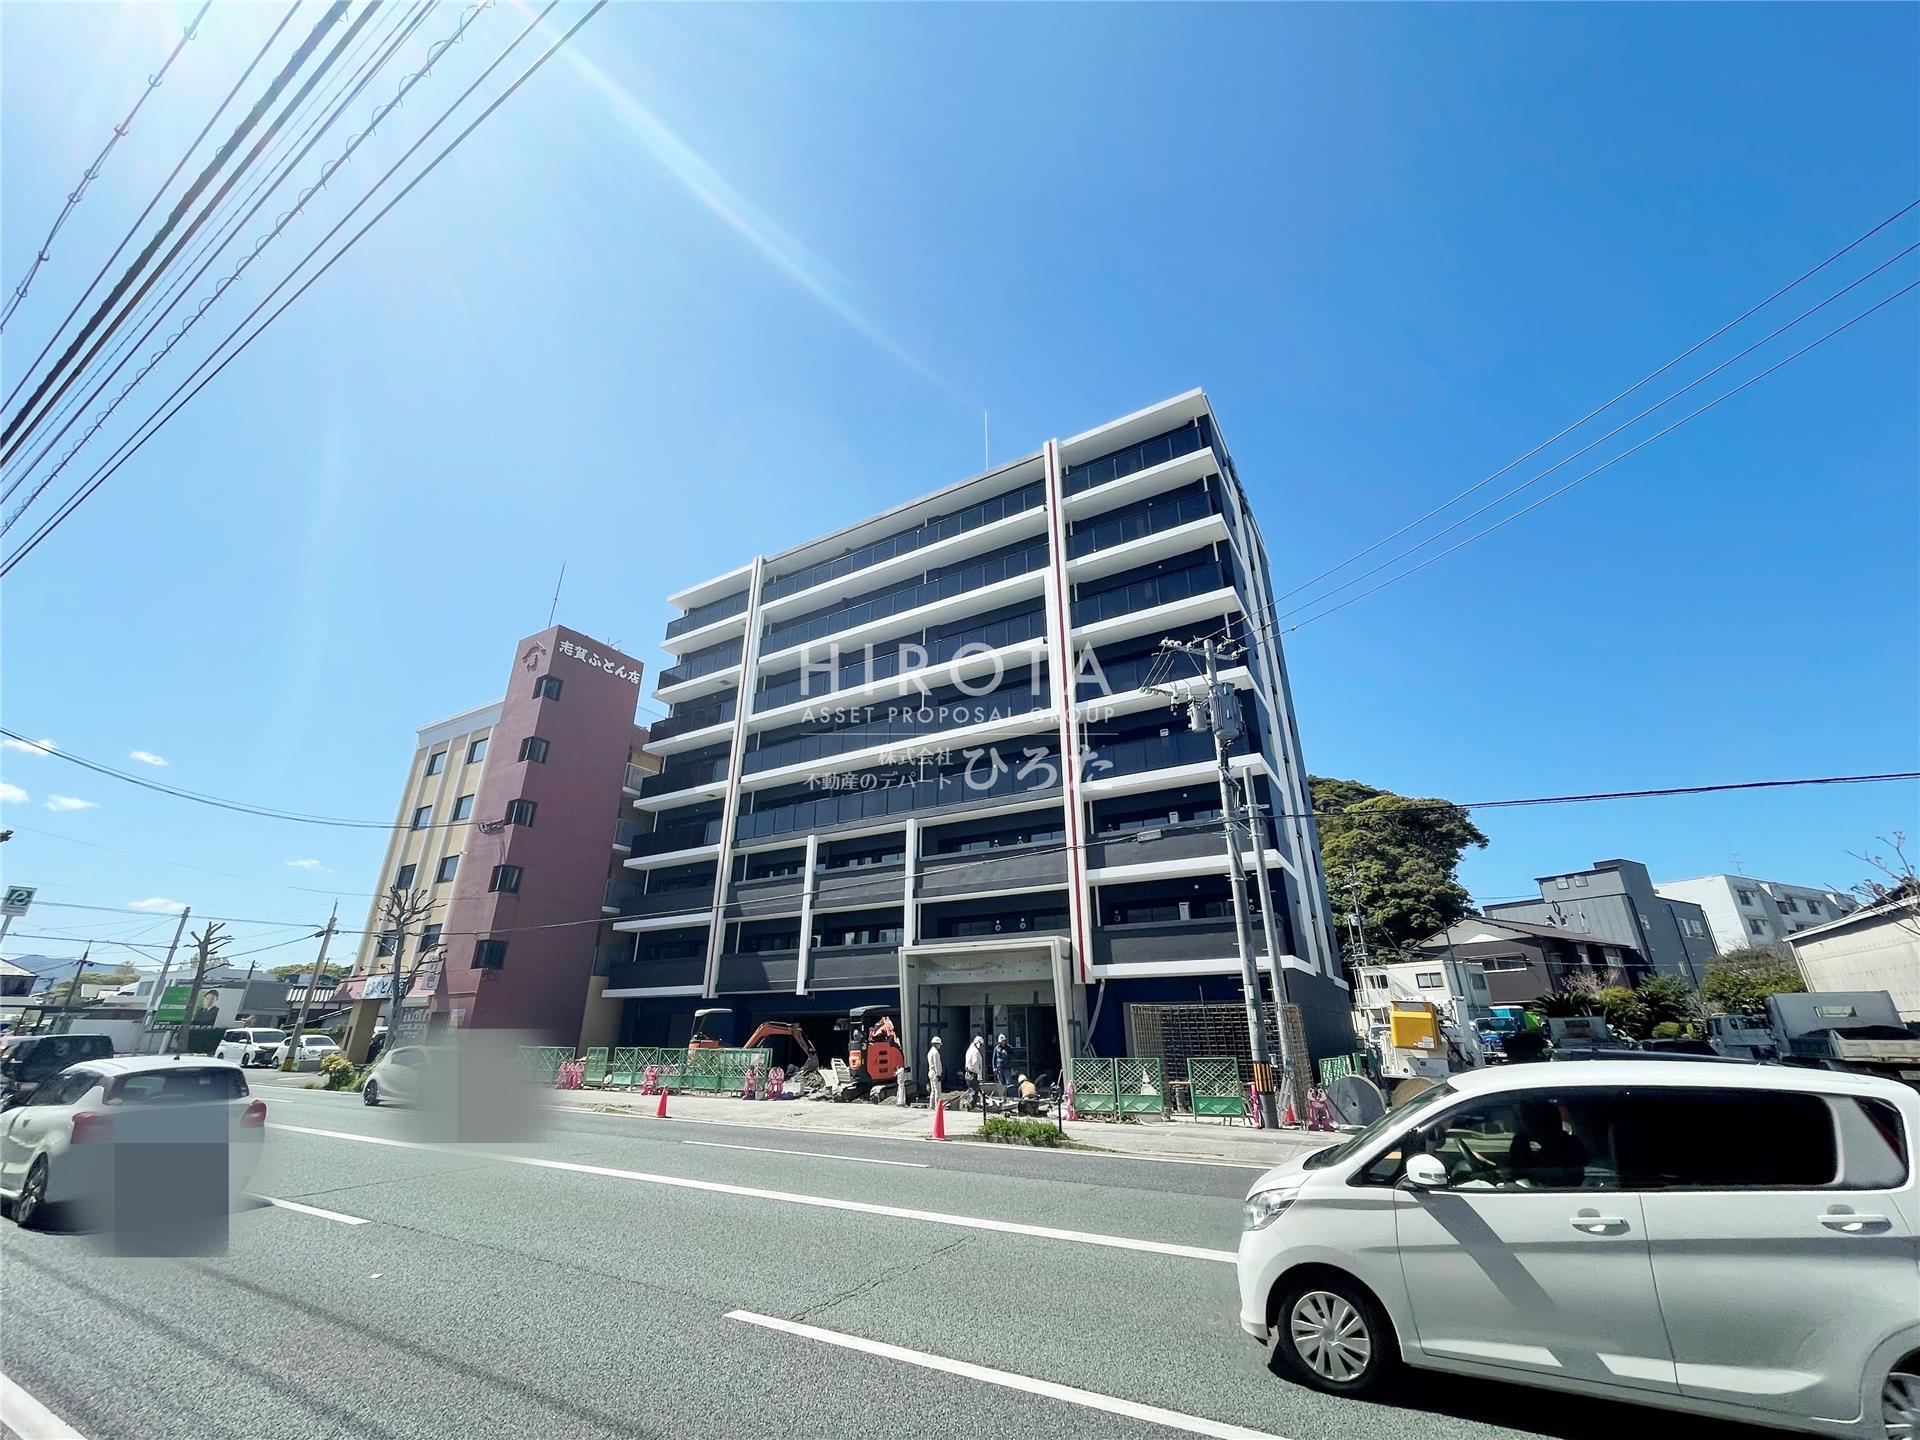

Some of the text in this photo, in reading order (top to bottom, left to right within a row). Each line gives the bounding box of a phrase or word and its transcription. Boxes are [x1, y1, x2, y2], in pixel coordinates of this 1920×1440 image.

[559, 640, 641, 684] 志賀ふとん店
